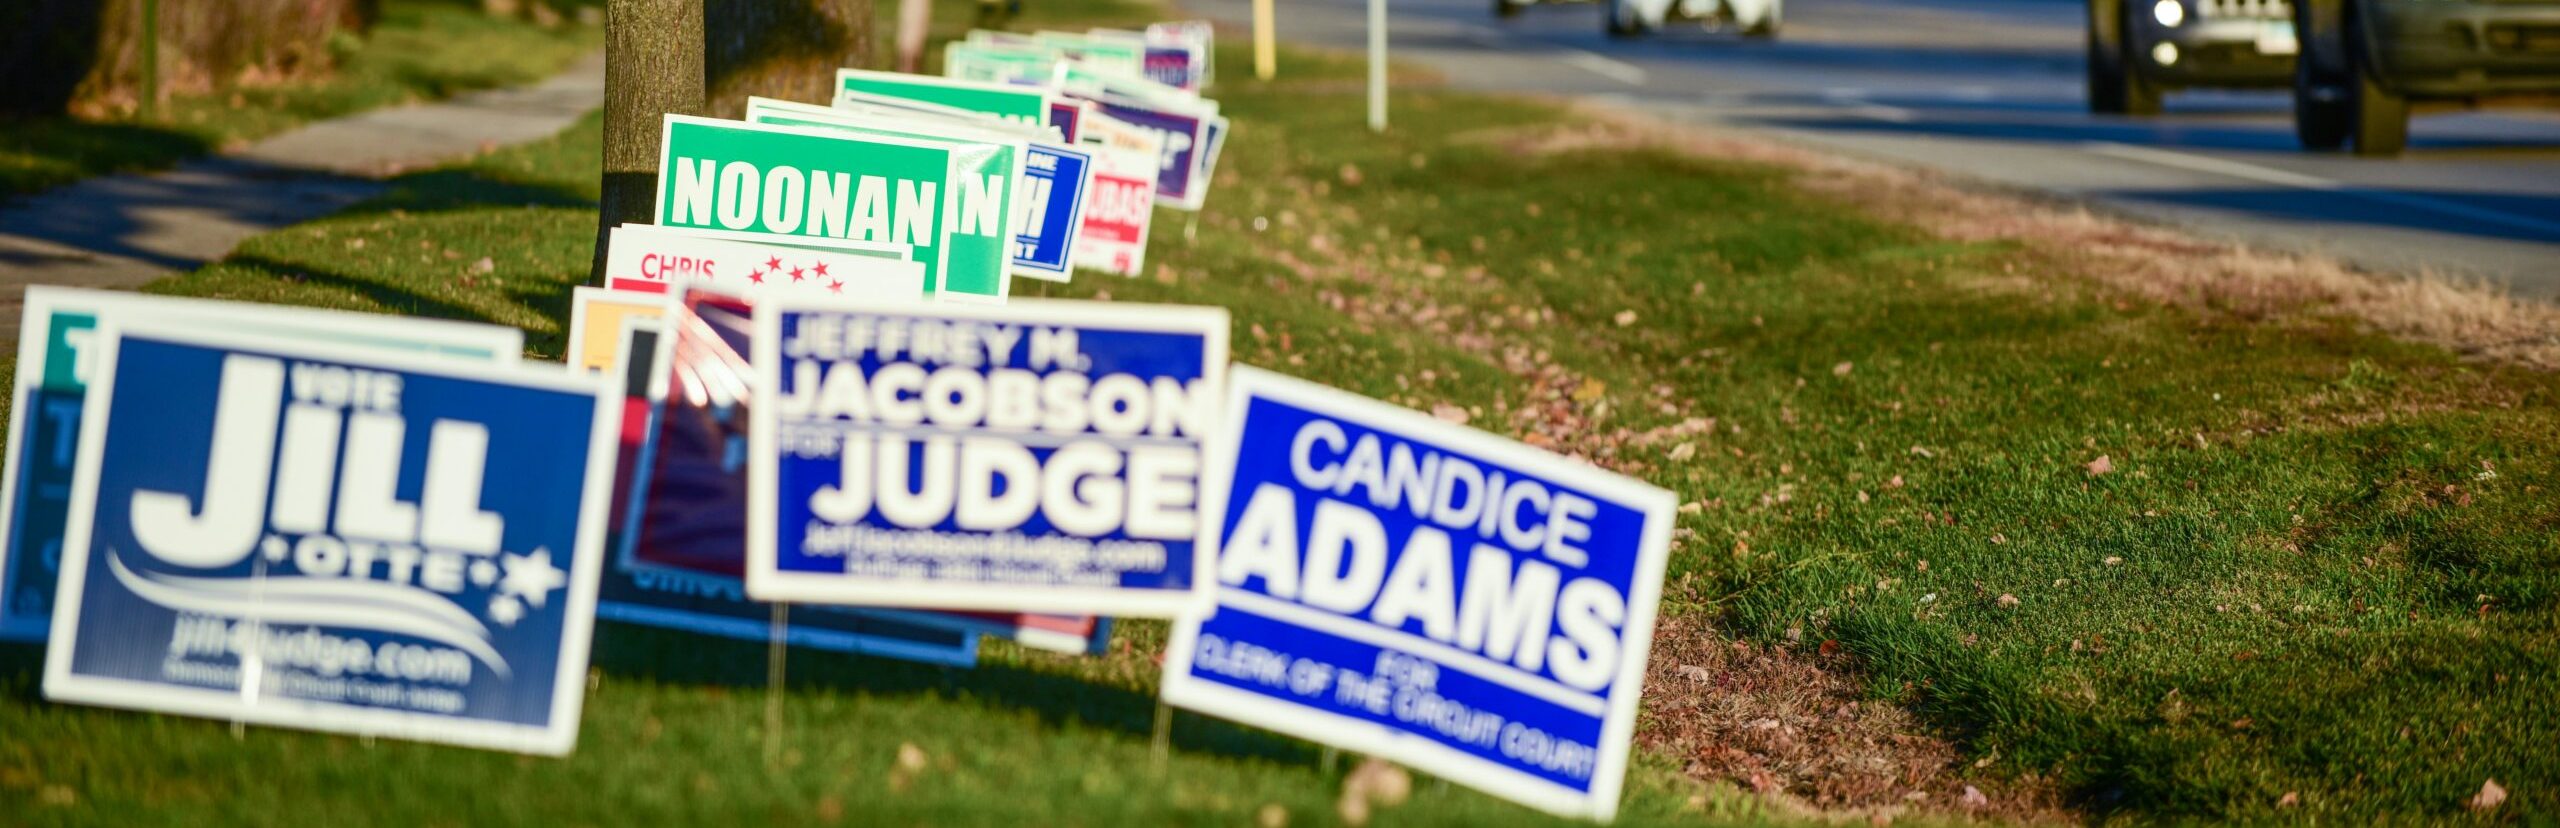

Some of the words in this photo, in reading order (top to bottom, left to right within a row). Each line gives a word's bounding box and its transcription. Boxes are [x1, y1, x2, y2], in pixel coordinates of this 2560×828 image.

[671, 156, 937, 248] NOONAN
[641, 252, 716, 281] CHRIS
[781, 312, 1024, 370] JEFFREY
[289, 360, 405, 412] VOTE
[781, 359, 1203, 436] JACOBSON
[130, 352, 504, 570] JILL
[809, 432, 1199, 540] JUDGE
[1290, 418, 1599, 570] CANDICE
[294, 535, 470, 594] OTTE
[1217, 481, 1627, 694] ADAMS
[1194, 633, 1290, 690] CLERK
[1287, 657, 1335, 698] OF
[1335, 668, 1393, 717] THE
[1391, 684, 1505, 751] CIRCUIT
[1500, 721, 1598, 782] COURT
[1374, 650, 1440, 694] FOR
